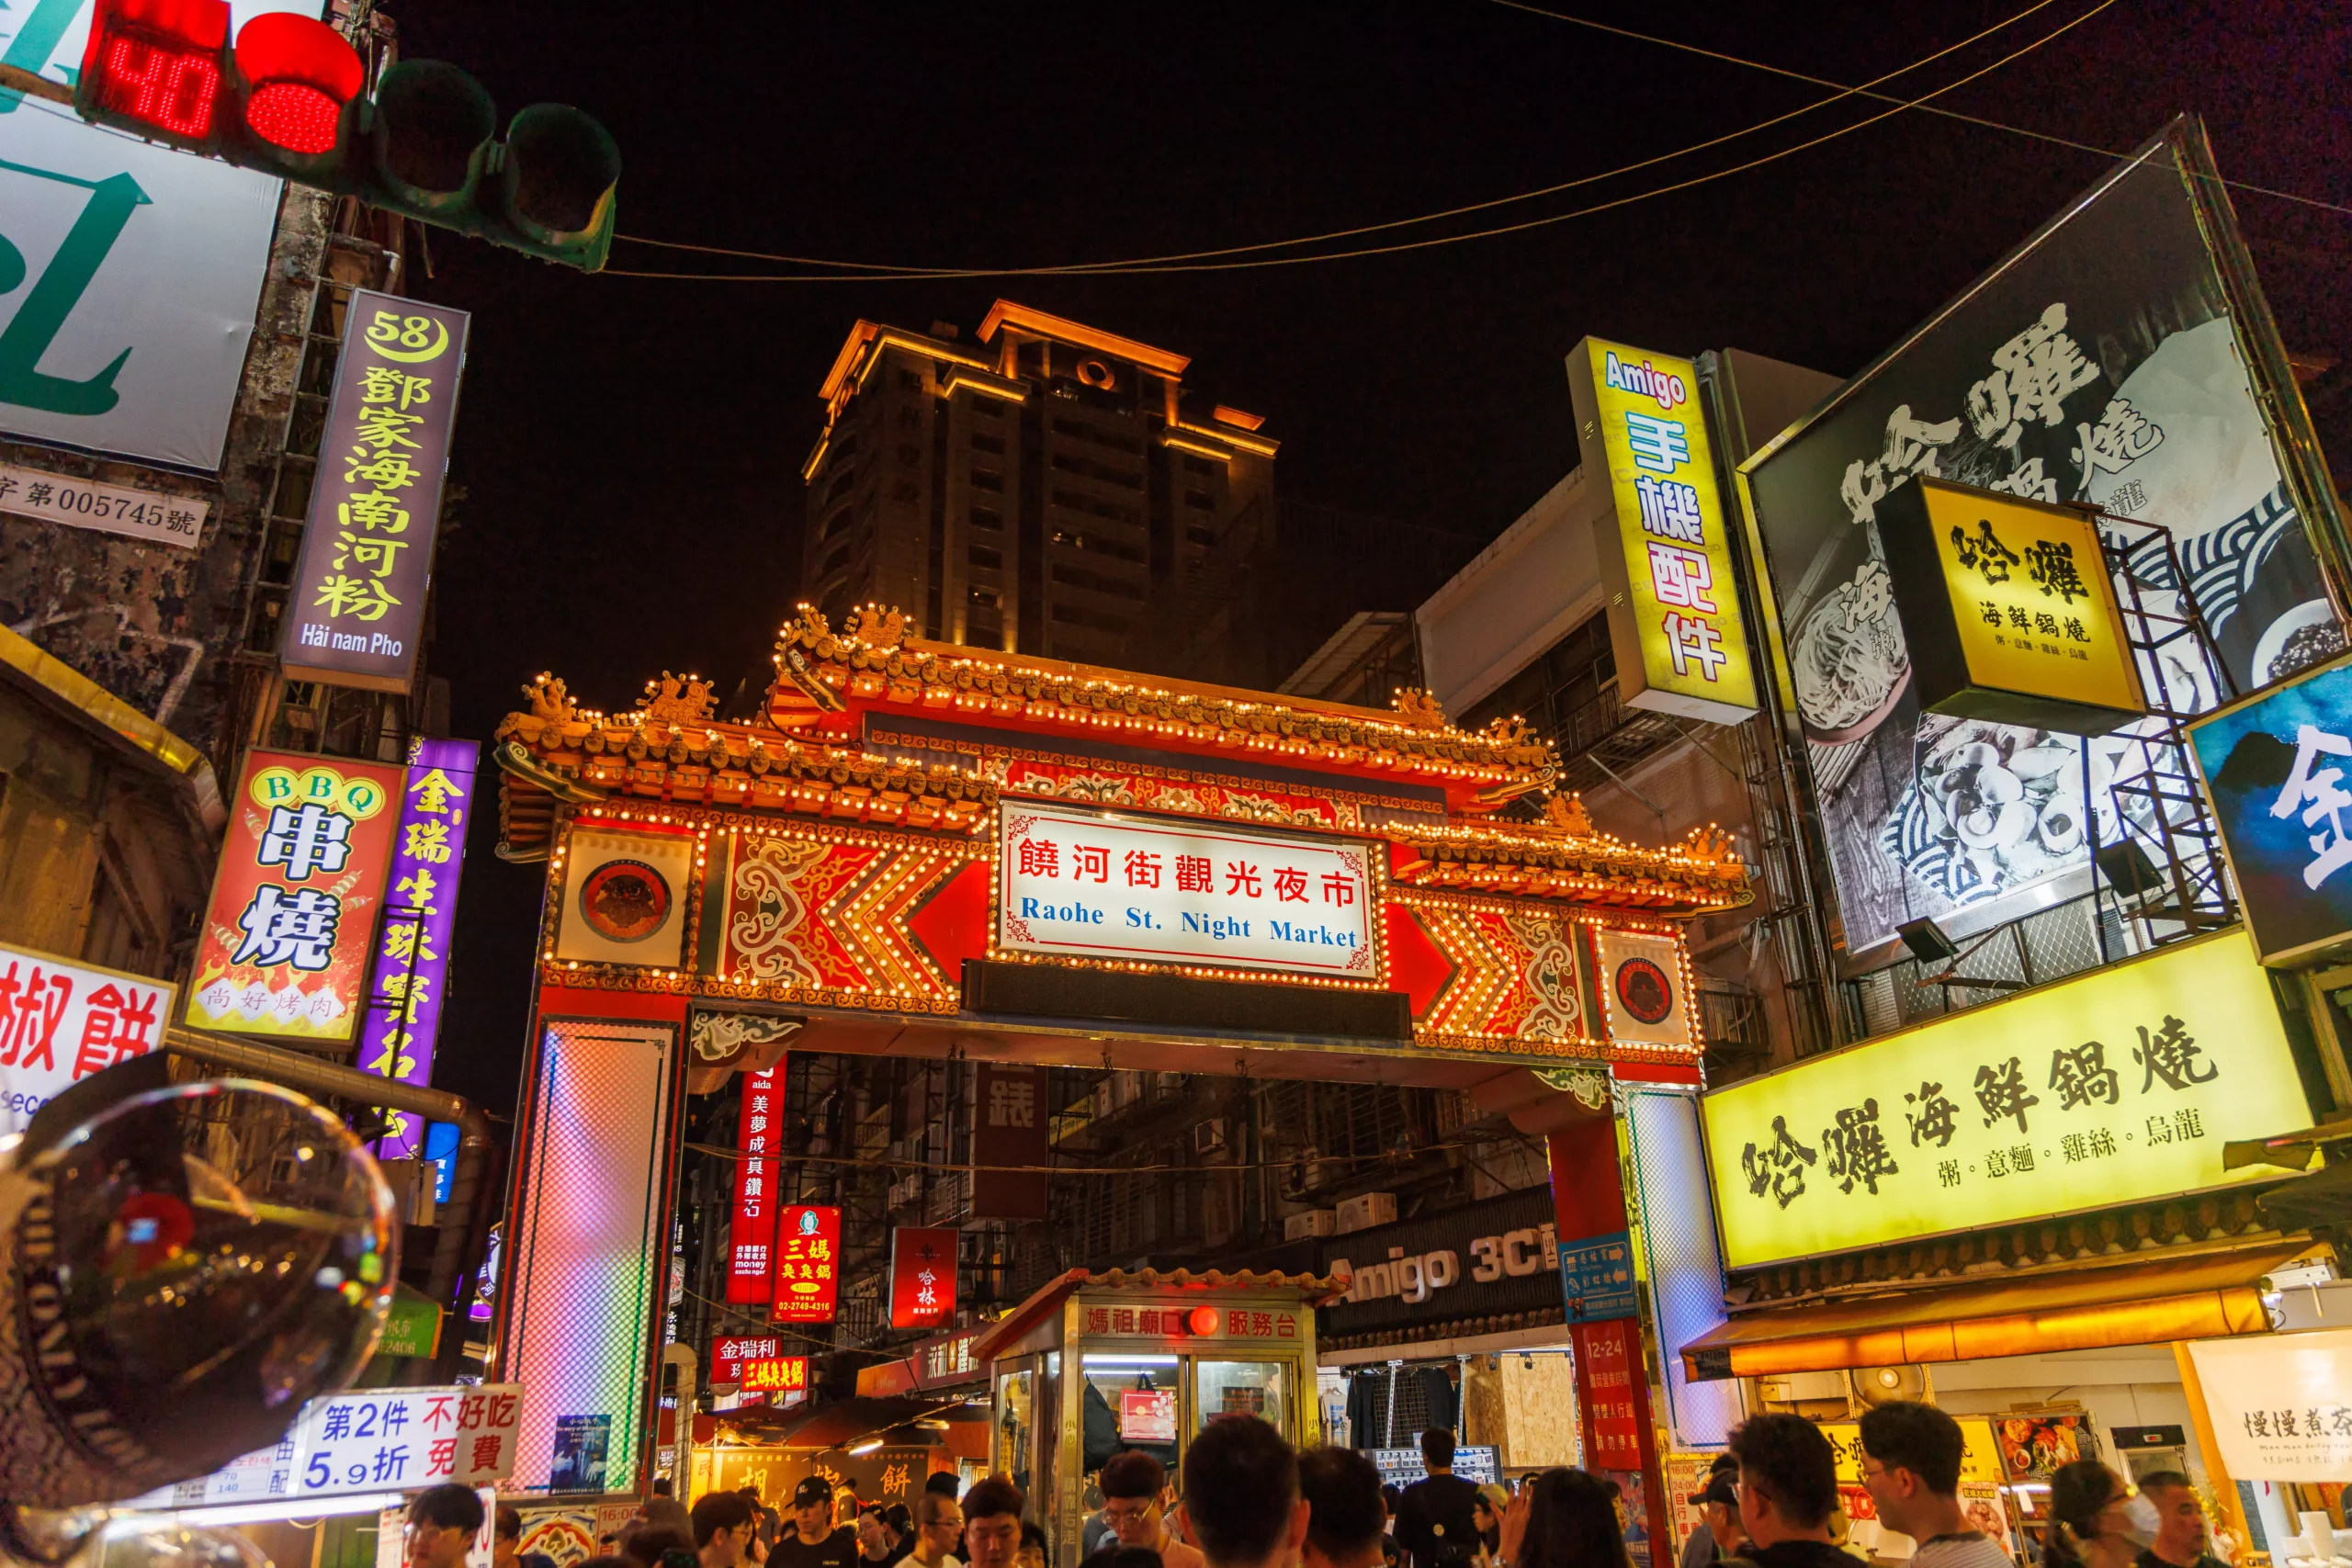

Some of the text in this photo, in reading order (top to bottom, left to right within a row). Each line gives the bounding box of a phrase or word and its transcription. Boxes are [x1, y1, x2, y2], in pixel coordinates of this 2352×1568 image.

[111, 39, 220, 135] 40
[367, 310, 431, 348] 58
[1606, 350, 1687, 411] Amigo
[314, 366, 432, 622] 鄧家海南河粉
[1625, 410, 1726, 683] 手機配件
[1951, 519, 2090, 605] 哈囉
[1979, 600, 2092, 644] 海鮮鍋燒
[332, 632, 368, 653] nam
[370, 632, 402, 657] Pho
[266, 774, 374, 813] BBQ
[232, 803, 354, 970] 串燒
[1018, 837, 1355, 908] 饒河街觀光夜市
[1020, 896, 1357, 948] Raohe St. Night Market
[207, 987, 333, 1018] 尚好烤肉
[752, 1079, 772, 1090] aida
[743, 1095, 769, 1218] 美夢成真鑽石
[735, 1260, 766, 1270] money
[784, 1239, 831, 1262] 三媽
[1326, 1246, 1460, 1308] Amigo
[1471, 1227, 1541, 1283] 3C
[782, 1262, 831, 1280] 臭臭鍋
[917, 1268, 937, 1306] 哈林
[778, 1301, 831, 1311] 02-2749-4316
[1087, 1307, 1297, 1338] 媽祖廟口 服務台
[719, 1338, 776, 1360] 金瑞利
[745, 1358, 804, 1389] 三媽臭臭鍋
[322, 1399, 410, 1441] 第2件
[423, 1393, 517, 1433] 不好吃
[2243, 1406, 2352, 1439] 慢慢煮茶
[1064, 1419, 1077, 1446] 小心
[304, 1445, 410, 1489] 5.9折
[425, 1436, 501, 1477] 免費
[1670, 1465, 1694, 1475] 16:00
[218, 1483, 239, 1494] 140
[224, 1472, 238, 1481] 70
[1673, 1481, 1696, 1491] 24:00
[1675, 1493, 1690, 1536] 自行車
